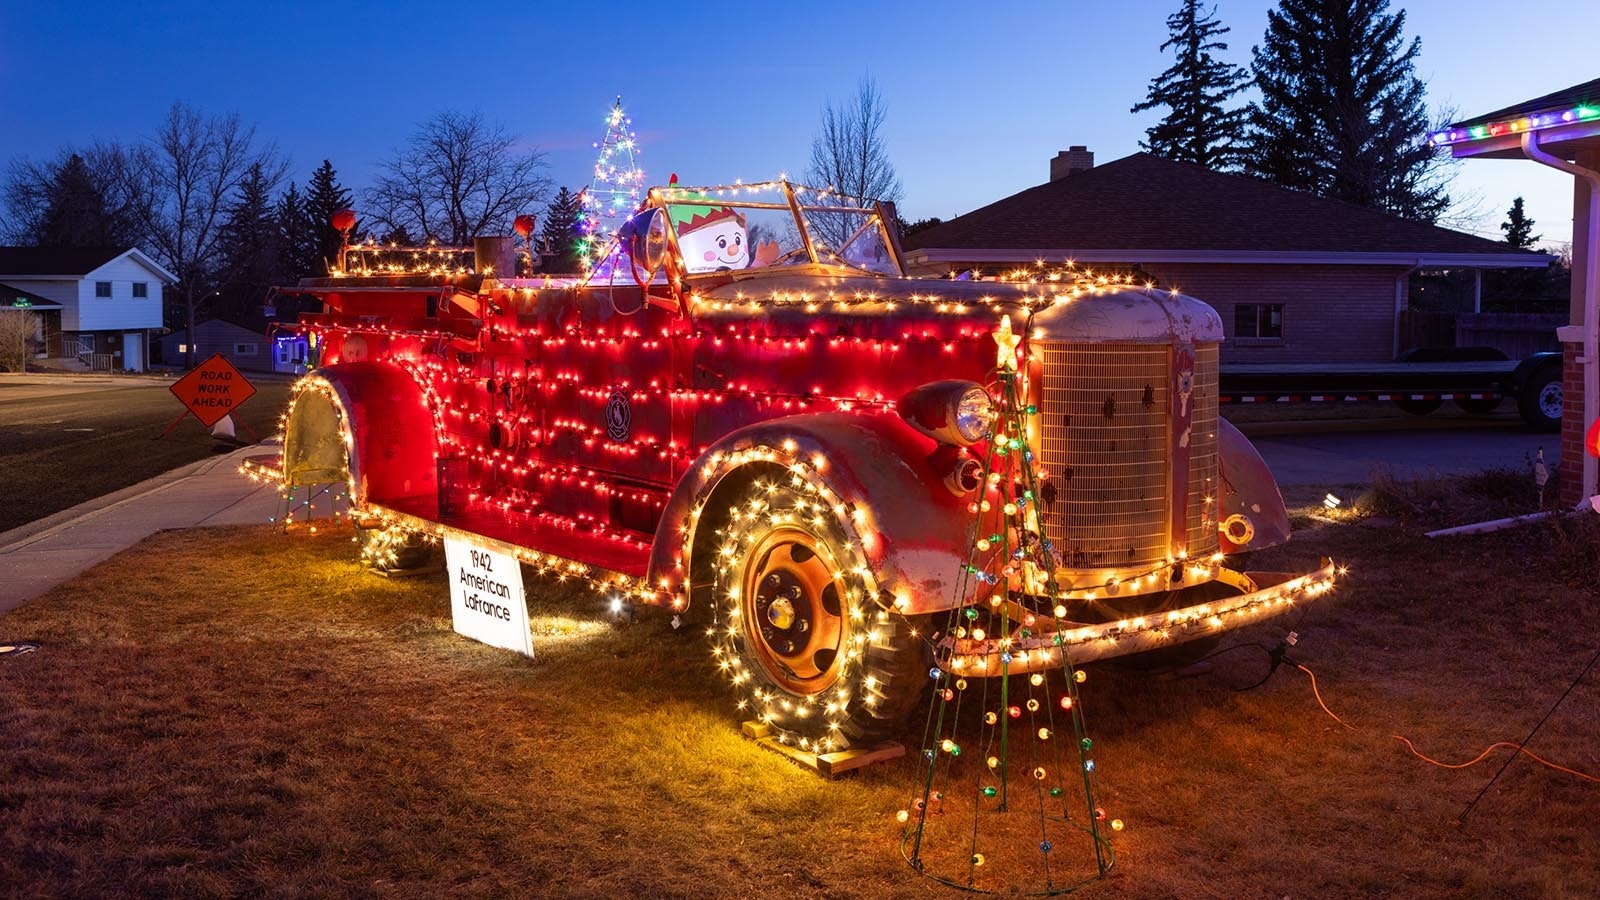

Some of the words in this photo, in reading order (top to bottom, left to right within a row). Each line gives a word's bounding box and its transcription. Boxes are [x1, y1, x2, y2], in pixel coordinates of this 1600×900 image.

[200, 371, 232, 380] ROAD
[199, 384, 230, 394] WORK
[192, 398, 232, 407] AHEAD
[470, 550, 493, 572] 1942
[460, 567, 511, 599] American
[463, 590, 511, 621] LaFrance
